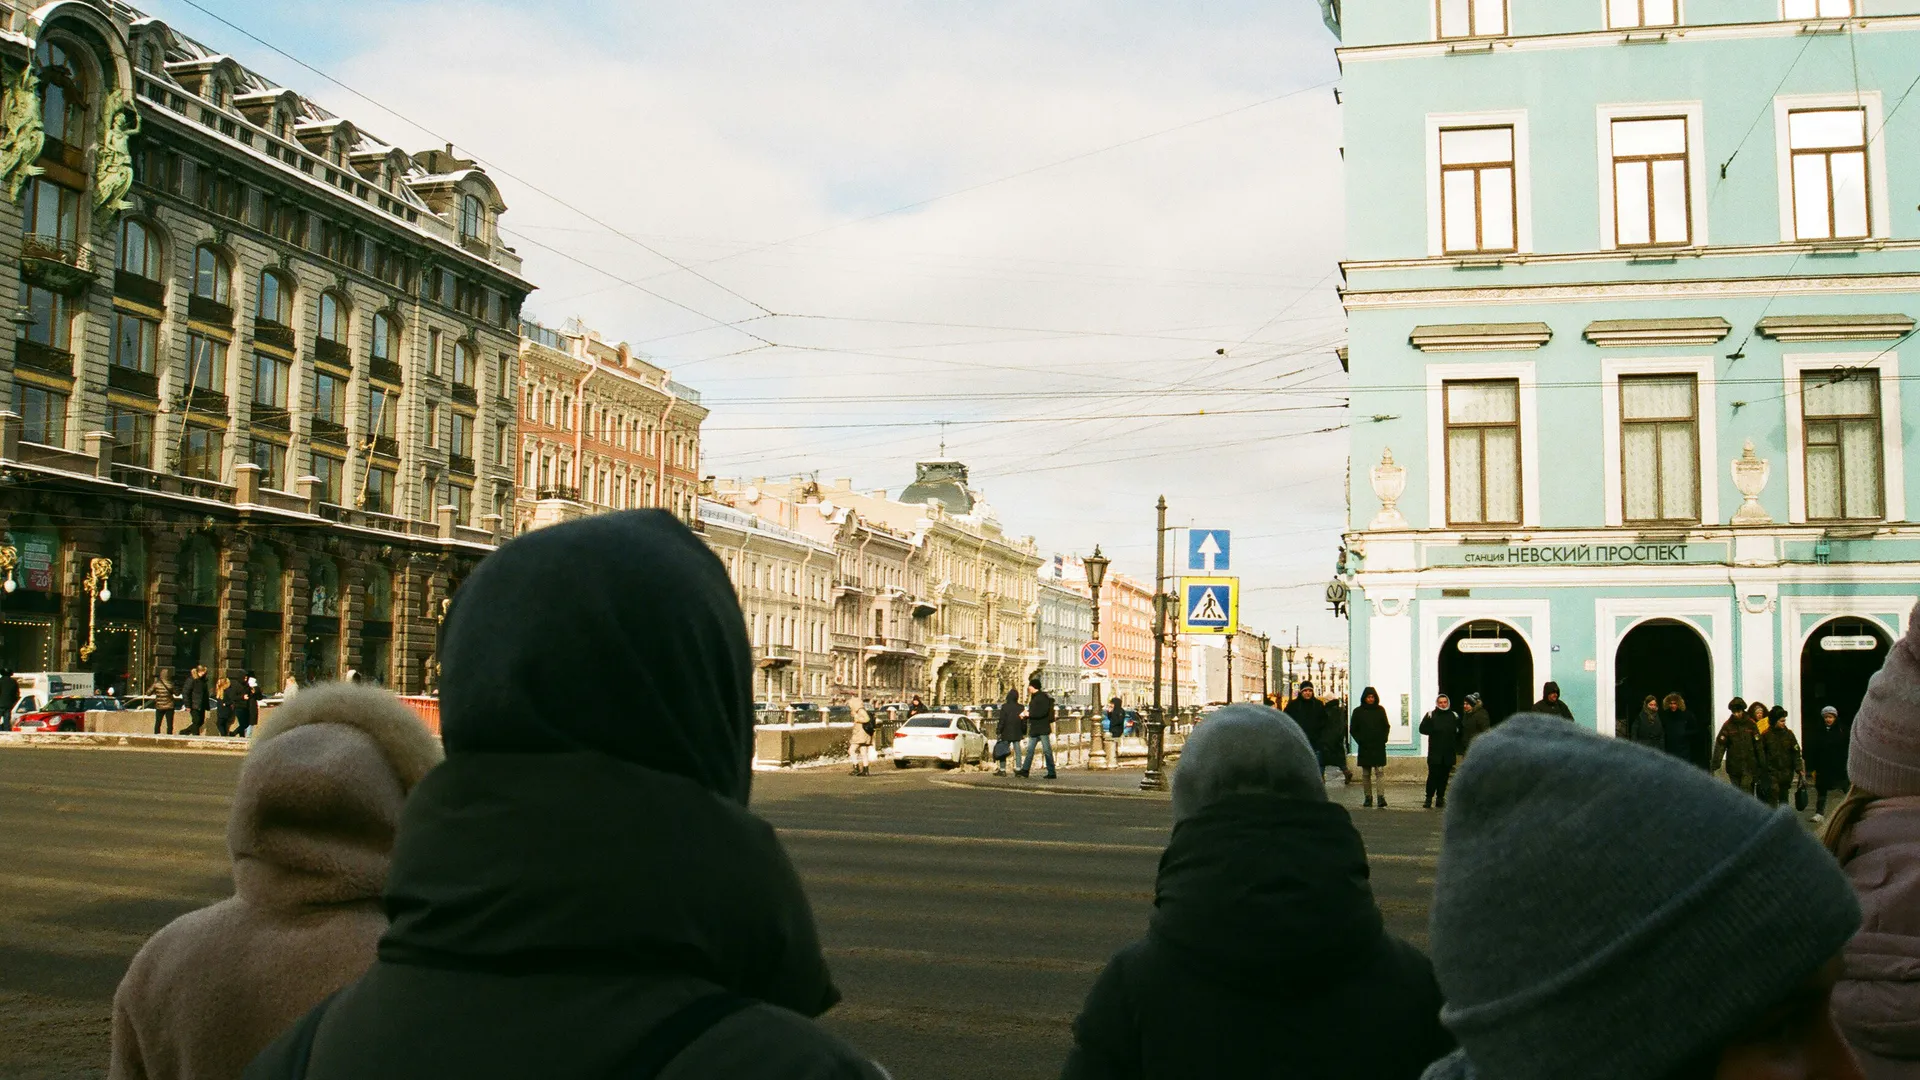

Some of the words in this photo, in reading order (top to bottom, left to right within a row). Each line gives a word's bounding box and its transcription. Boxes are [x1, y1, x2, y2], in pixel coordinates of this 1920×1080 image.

[1465, 553, 1504, 562] СТАНЦИЯ
[1508, 544, 1590, 562] НЕВСКИЙ
[1596, 545, 1688, 561] ПРОСПЕКТ
